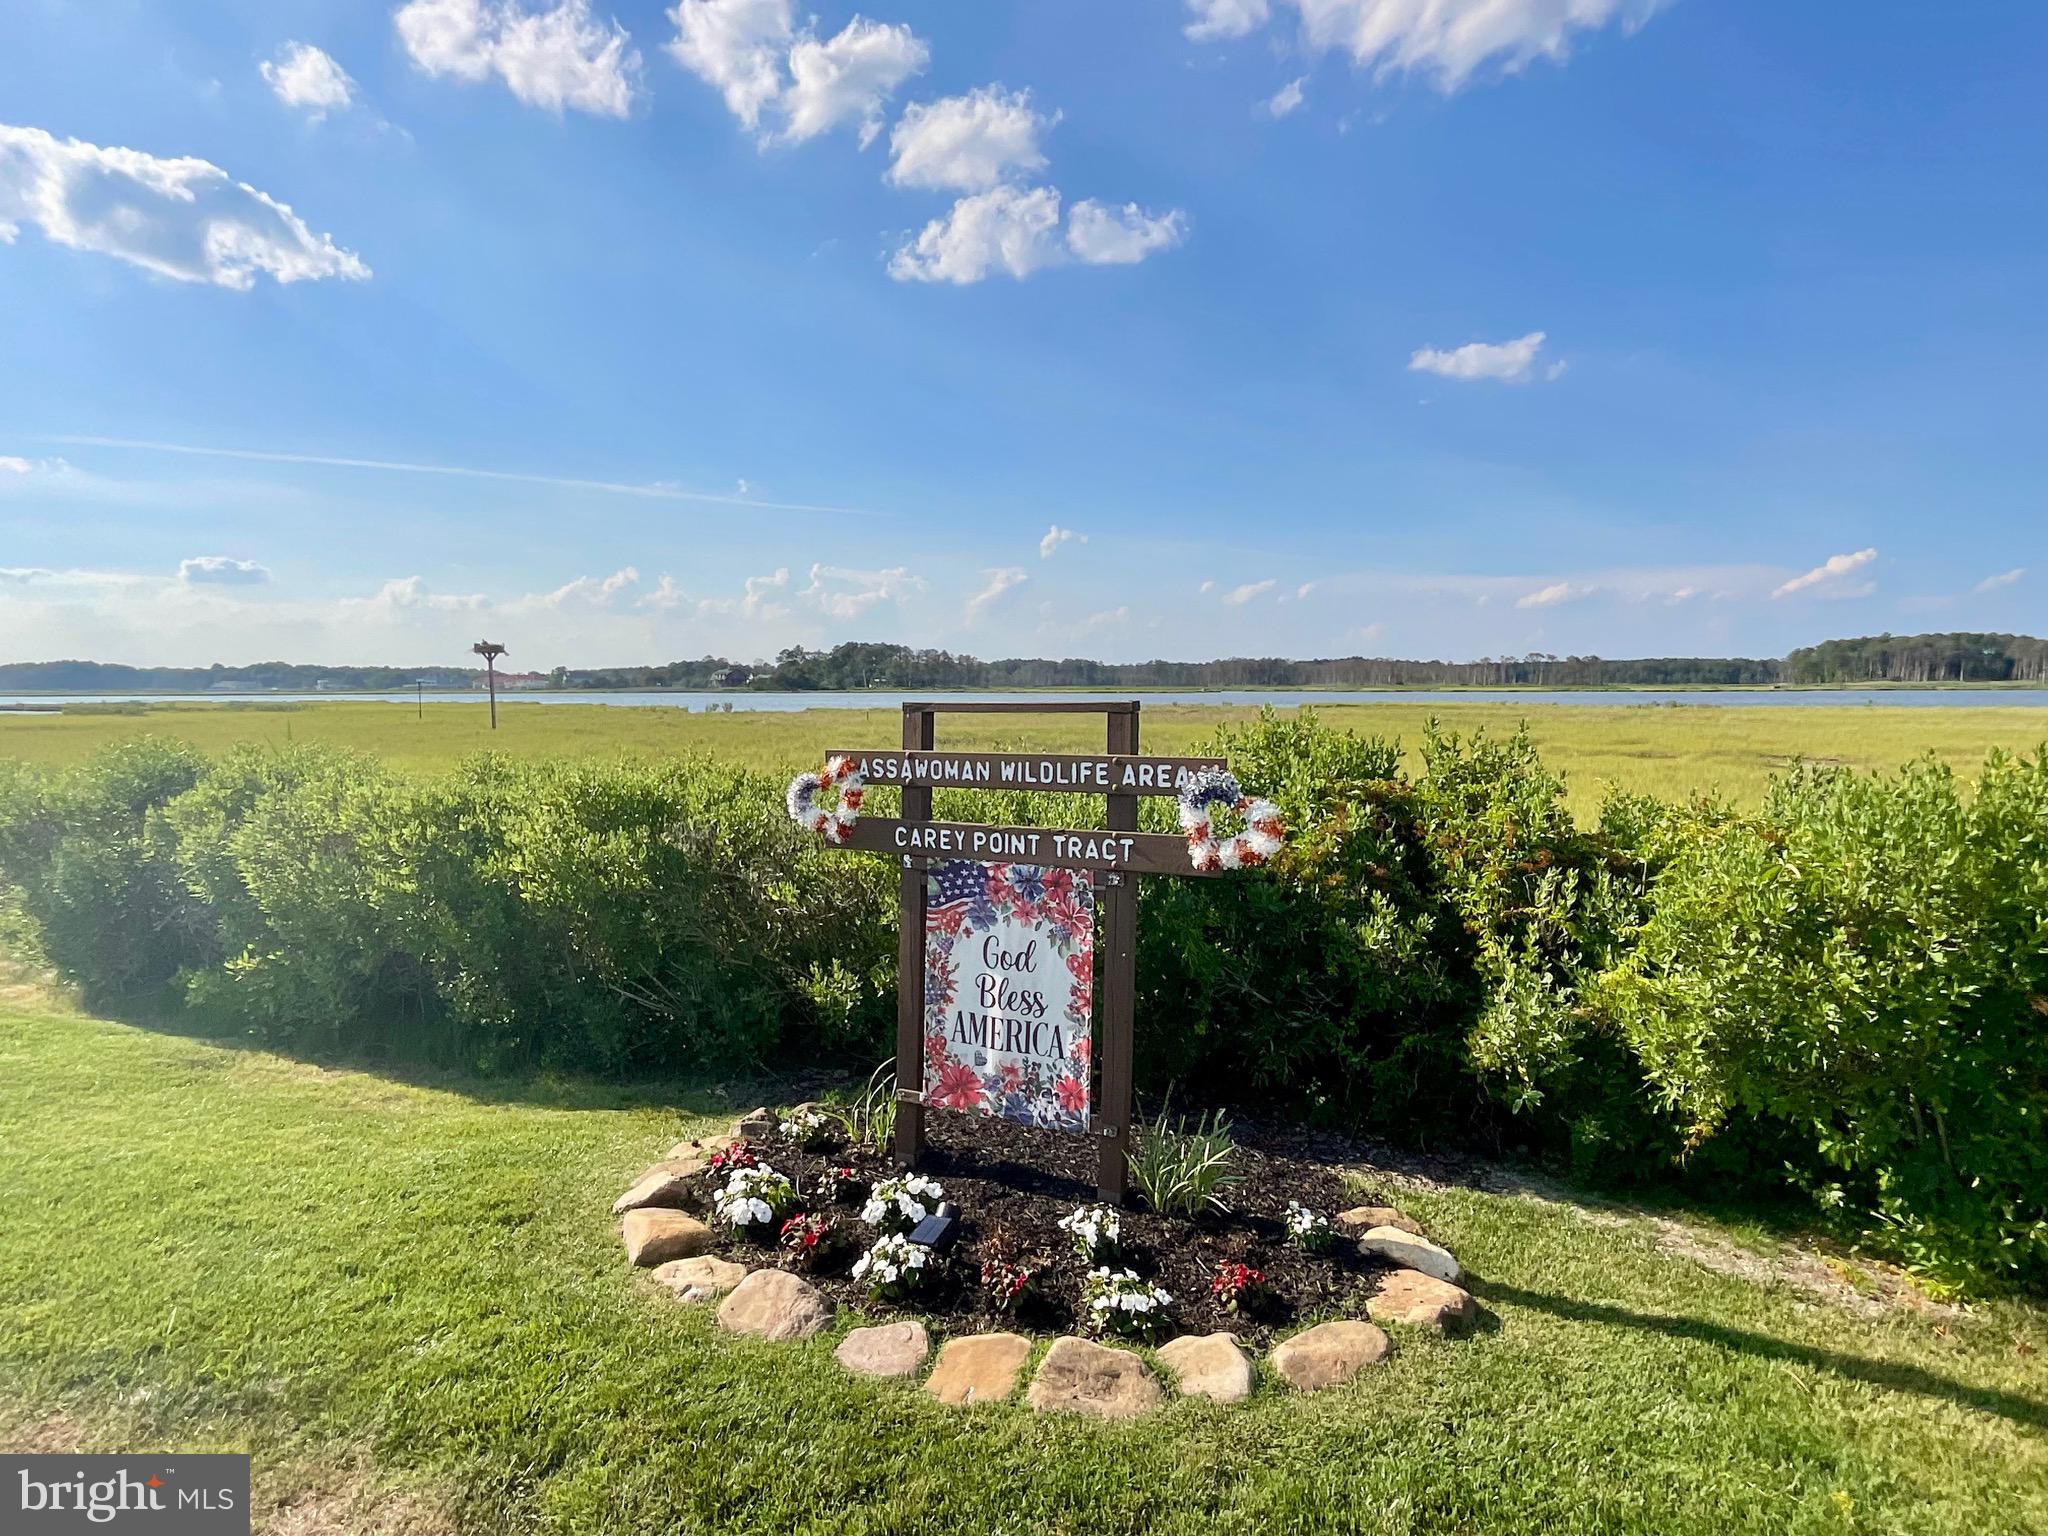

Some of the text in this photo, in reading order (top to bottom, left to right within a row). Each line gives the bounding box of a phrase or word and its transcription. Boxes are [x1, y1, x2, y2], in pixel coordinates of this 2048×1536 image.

[859, 758, 1188, 788] ASSAWOMAN WILDLIFE AREA
[894, 826, 1134, 862] CAREY POINT TRACT
[983, 934, 1038, 973] God
[975, 973, 1048, 1018] Bless
[951, 1010, 1067, 1060] AMERICA
